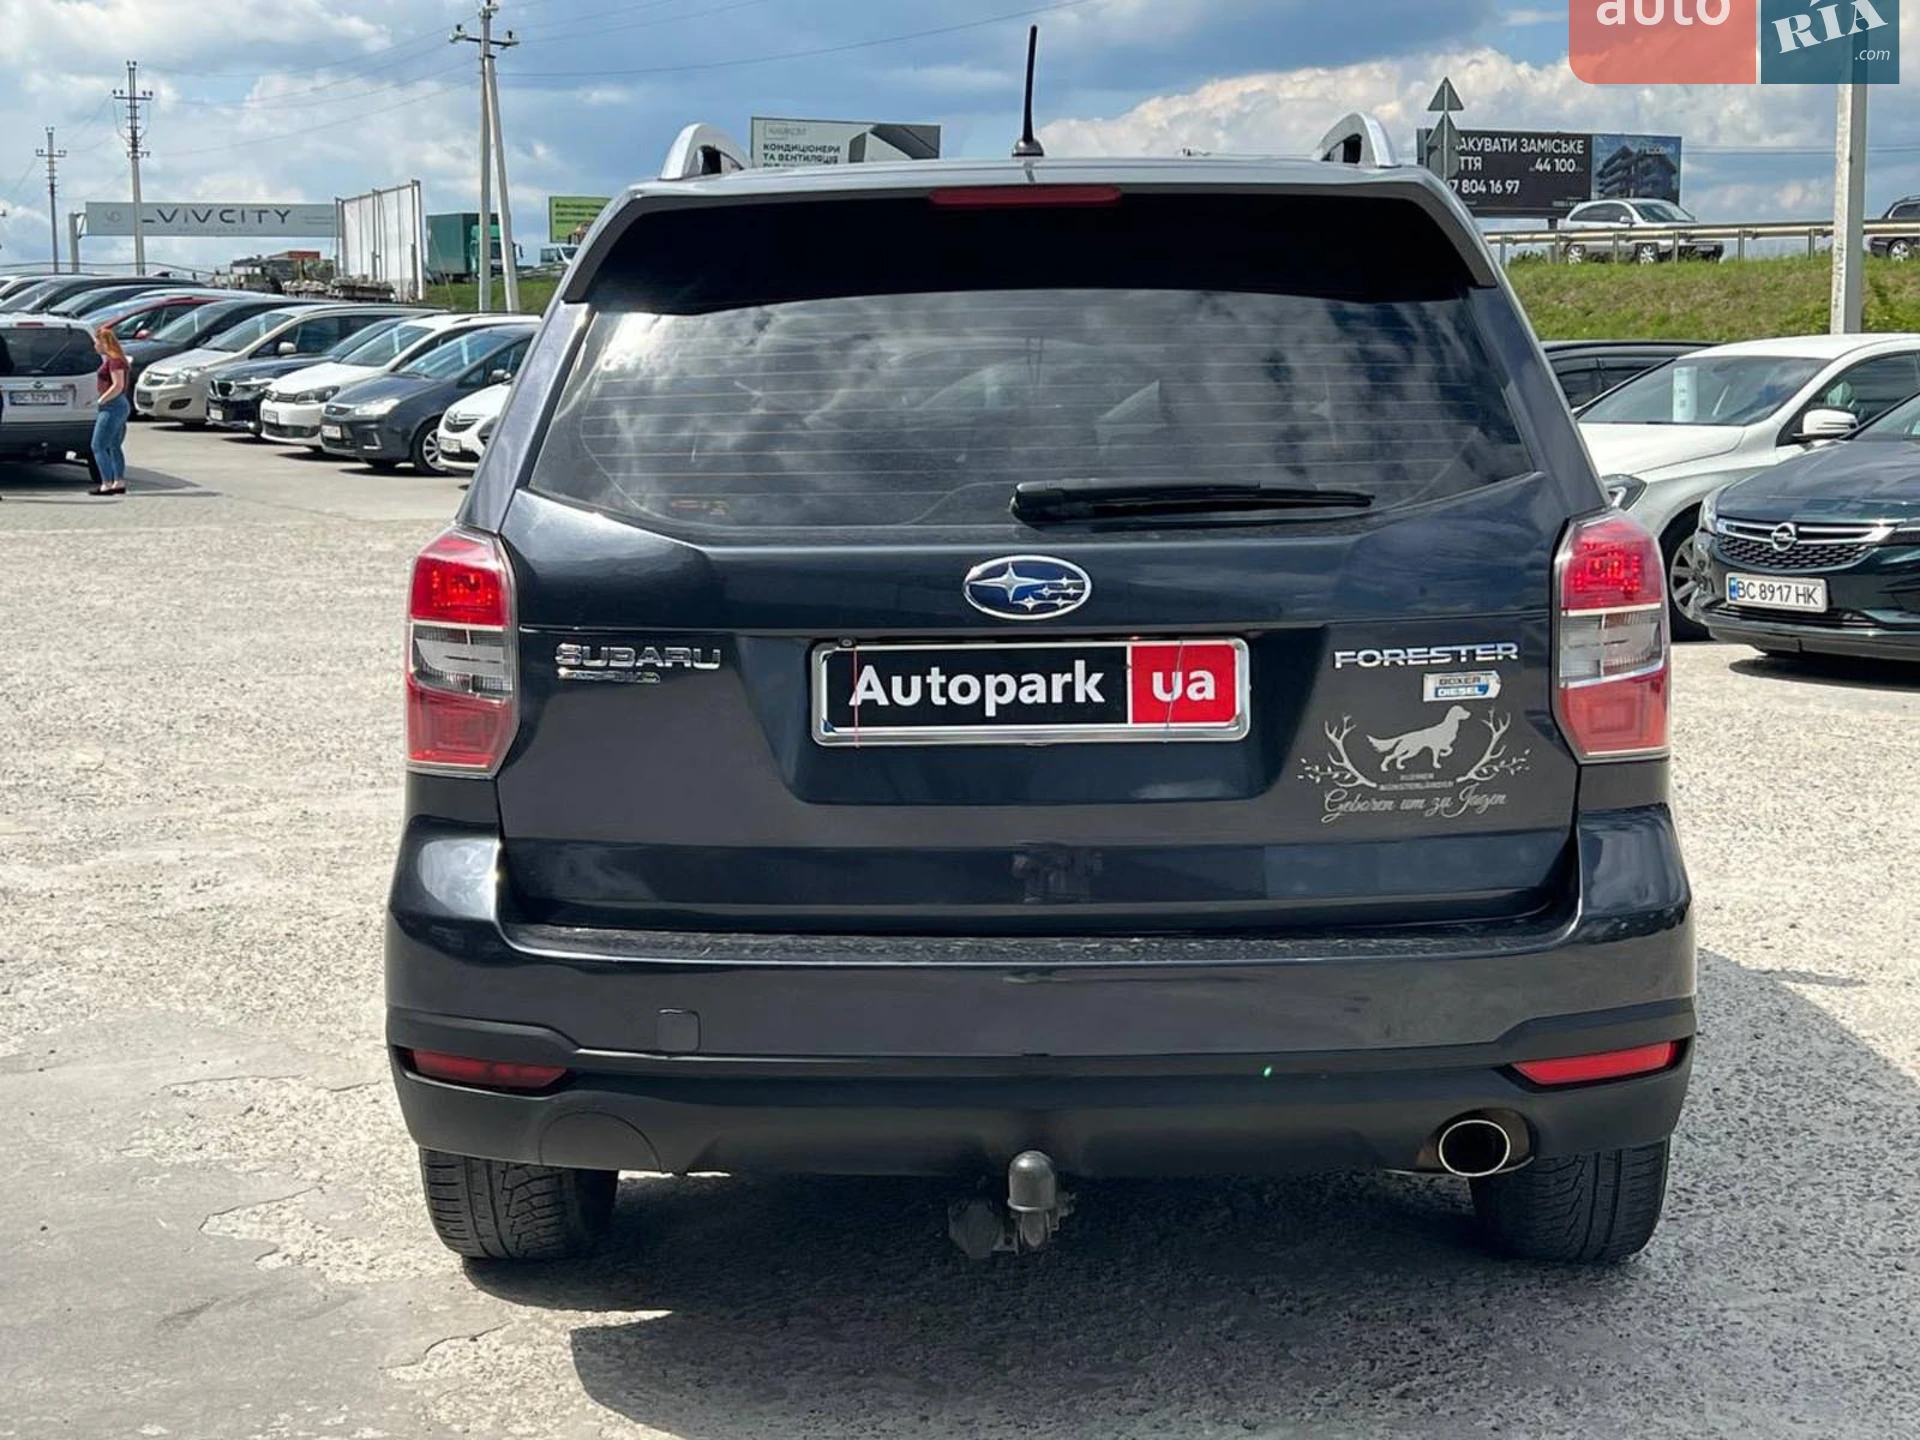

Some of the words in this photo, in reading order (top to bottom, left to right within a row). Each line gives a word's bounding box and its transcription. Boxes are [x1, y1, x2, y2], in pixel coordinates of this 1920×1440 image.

[1455, 137, 1518, 153] АКУВАТИ
[1520, 138, 1584, 155] ЗАМІСЬКЕ
[1534, 158, 1551, 173] 44
[1554, 158, 1575, 173] 100
[1462, 179, 1487, 194] 804
[1488, 180, 1503, 194] 16
[1504, 180, 1520, 194] 97
[1737, 581, 1756, 600] BC
[1759, 583, 1792, 603] 8917
[1795, 586, 1818, 605] HK
[555, 643, 720, 670] SUBARU
[1333, 642, 1519, 669] FORESTER
[849, 659, 1105, 717] Autopark
[1152, 669, 1216, 702] ua
[1437, 686, 1484, 698] DIESEL
